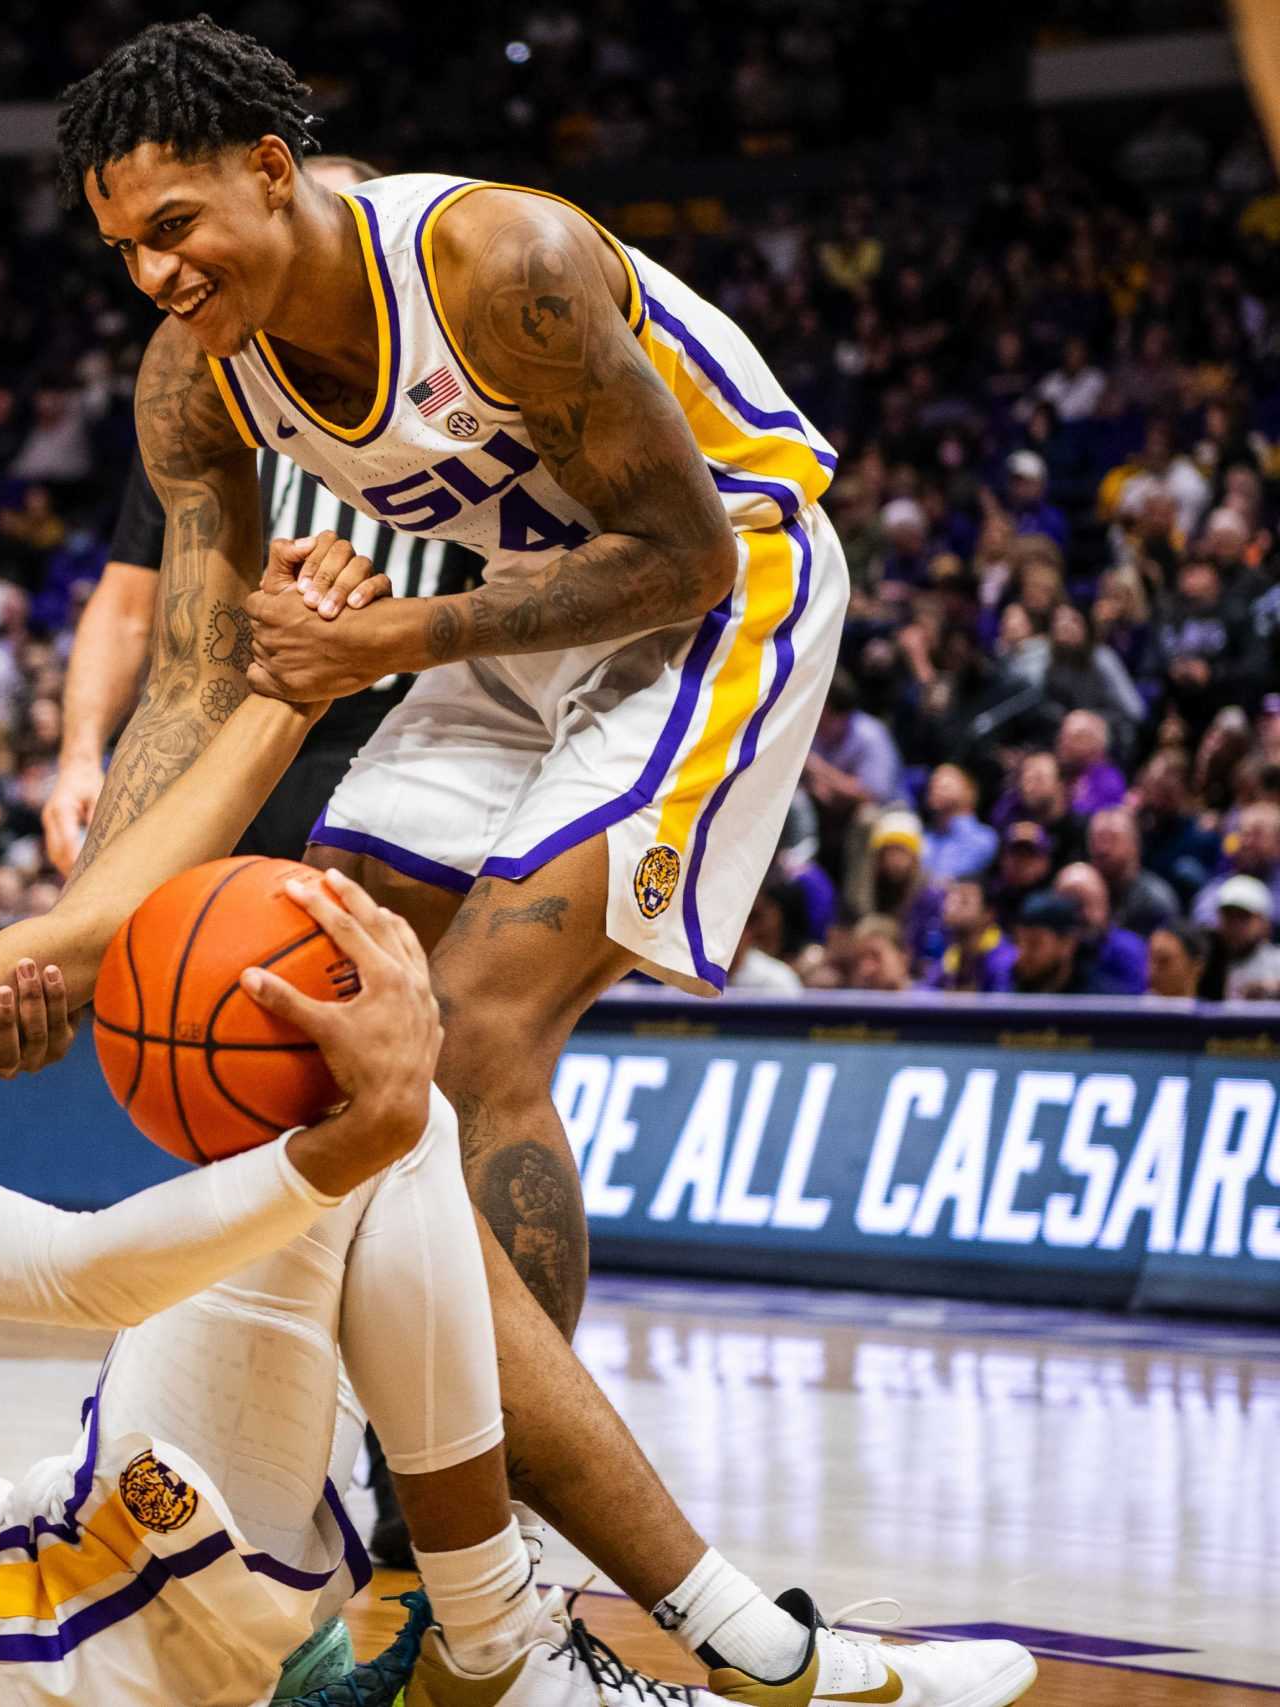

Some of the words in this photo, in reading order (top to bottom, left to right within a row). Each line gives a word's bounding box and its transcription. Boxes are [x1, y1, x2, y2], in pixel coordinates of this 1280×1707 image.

[361, 428, 540, 533] SU
[498, 483, 593, 552] 4
[551, 1053, 669, 1218] RE
[648, 1057, 837, 1231] ALL
